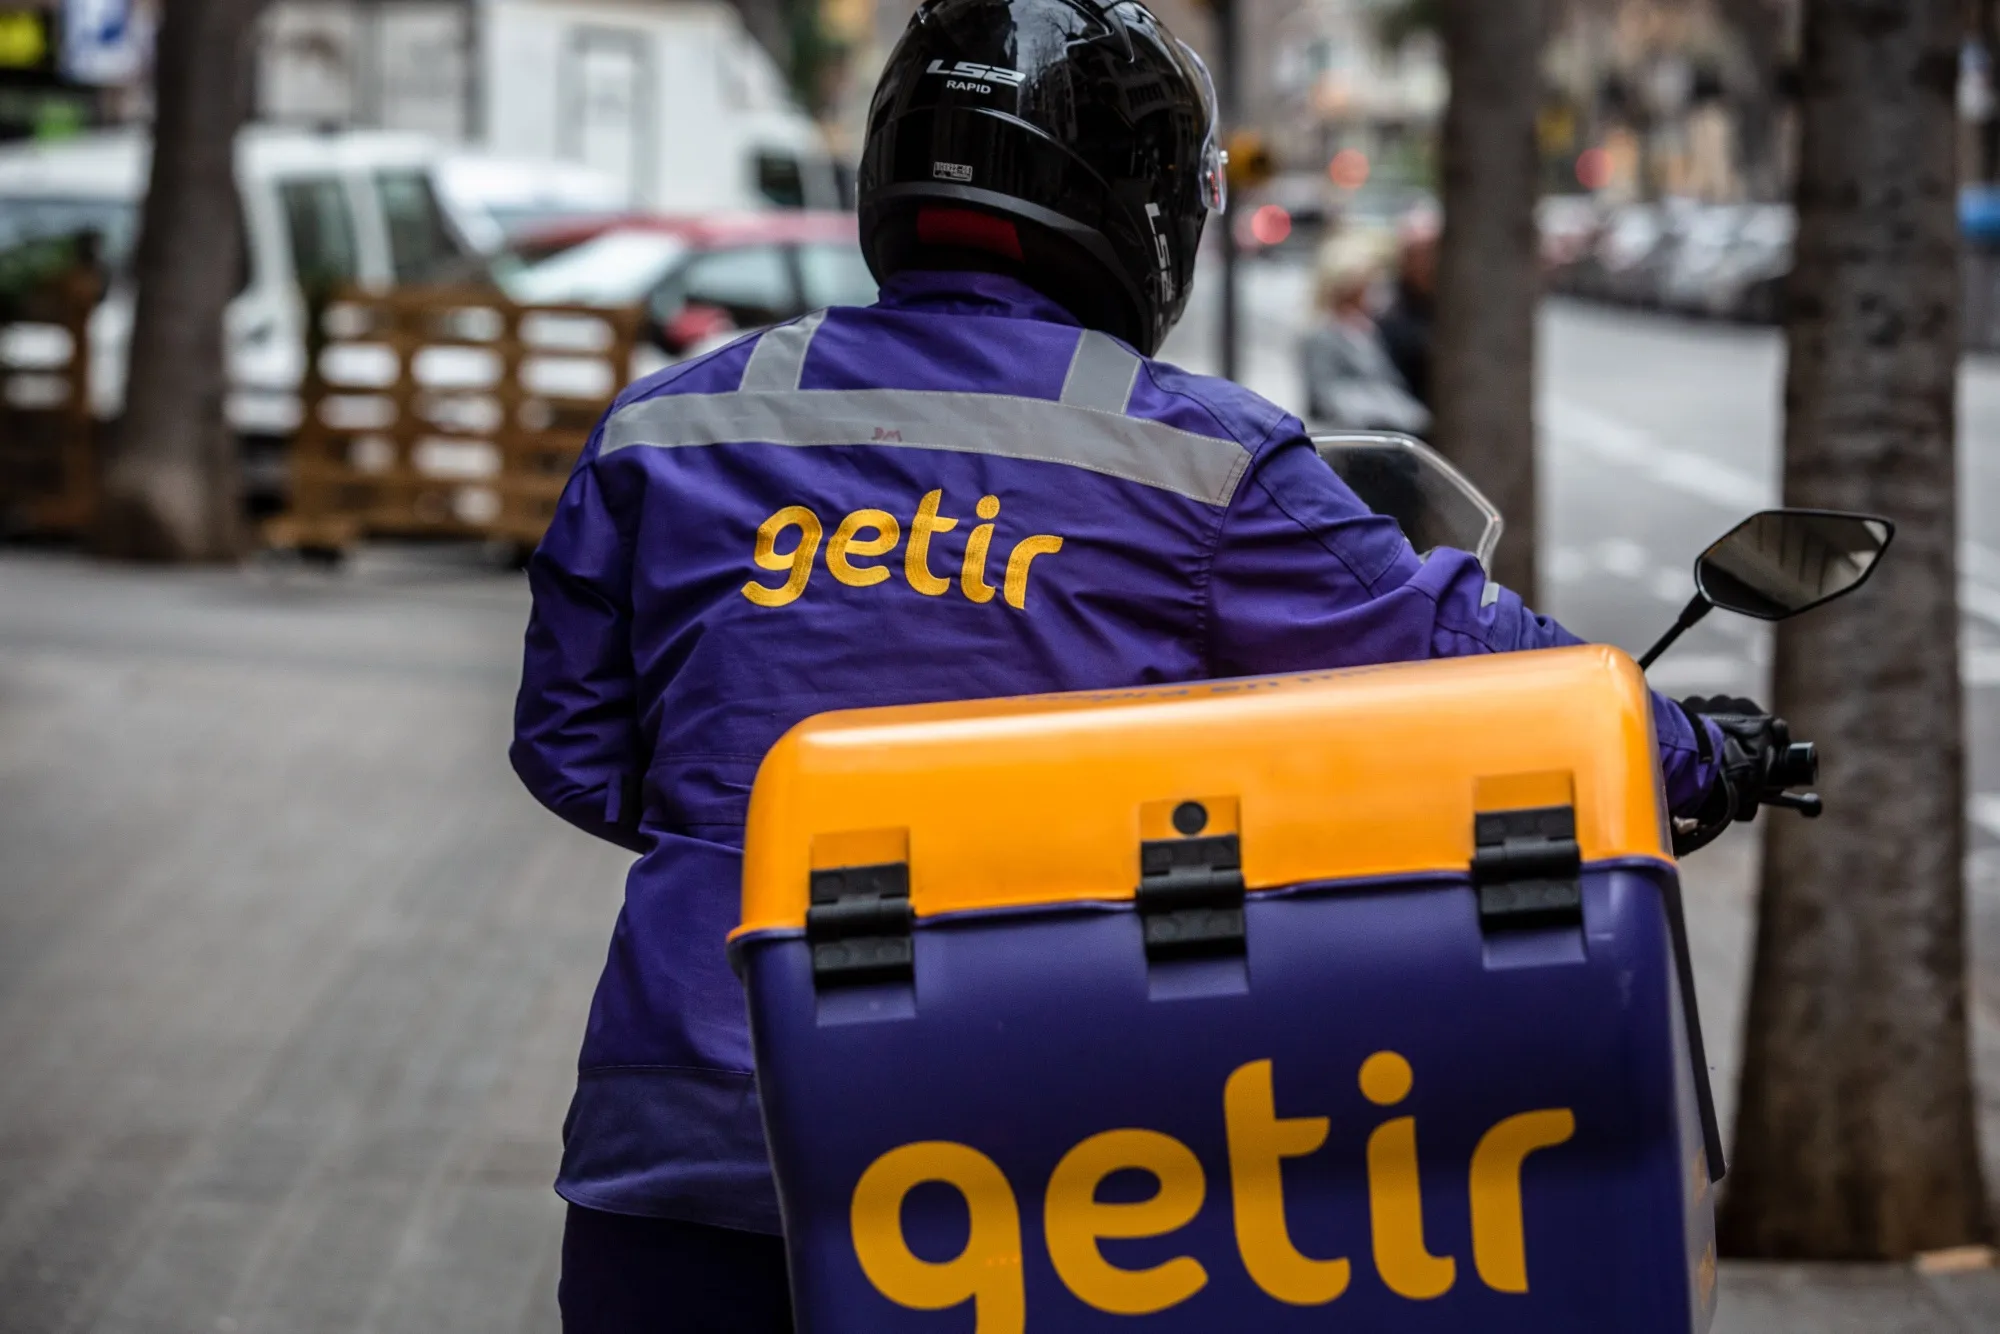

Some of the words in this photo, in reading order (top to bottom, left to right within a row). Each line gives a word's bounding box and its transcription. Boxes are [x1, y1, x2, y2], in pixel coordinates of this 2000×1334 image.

[926, 59, 1026, 87] LS2
[946, 80, 991, 94] RAPID
[741, 488, 1064, 610] getir
[850, 1050, 1575, 1334] getir
